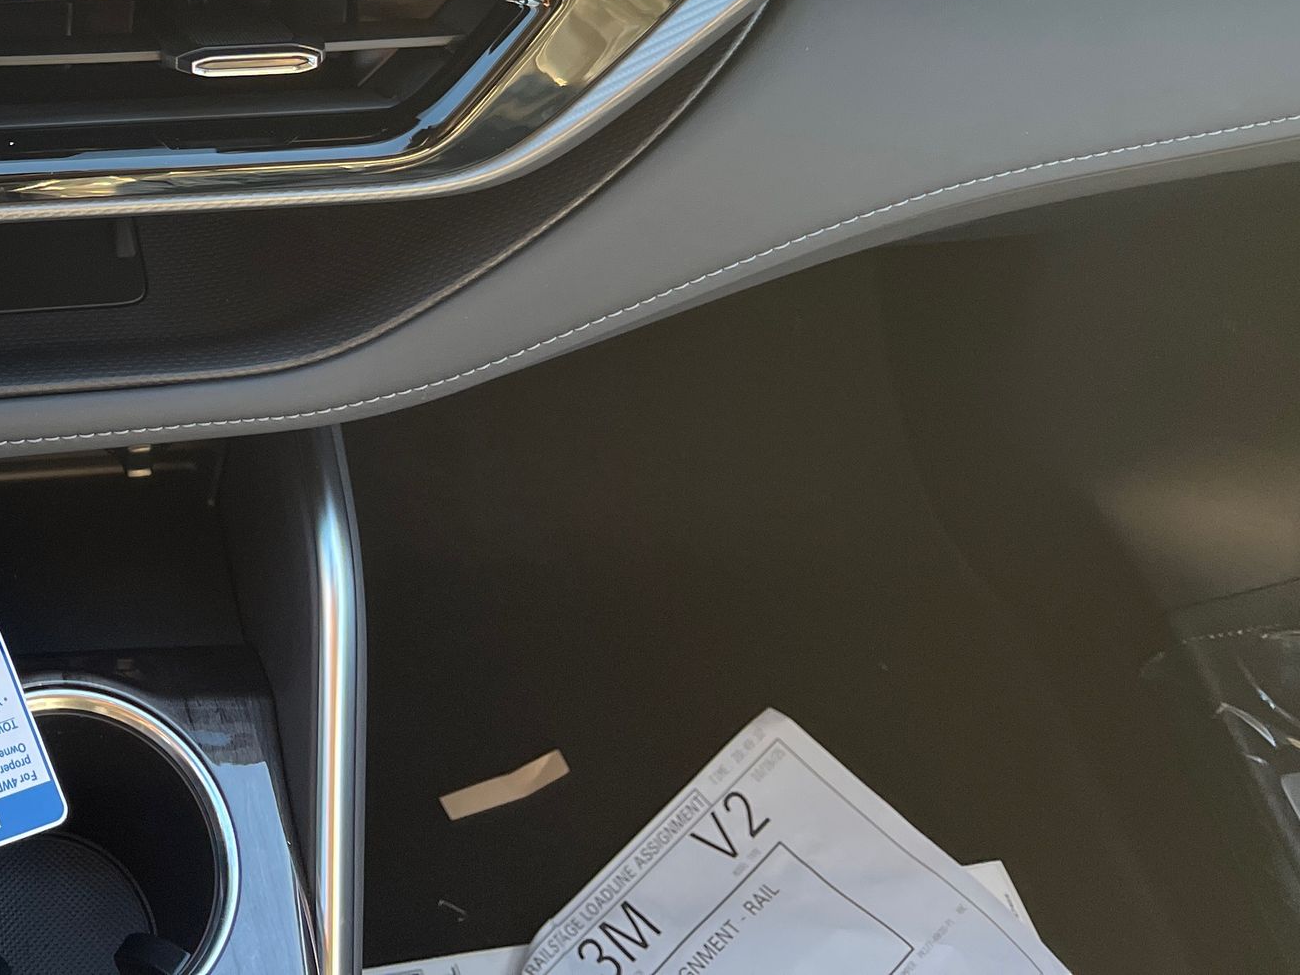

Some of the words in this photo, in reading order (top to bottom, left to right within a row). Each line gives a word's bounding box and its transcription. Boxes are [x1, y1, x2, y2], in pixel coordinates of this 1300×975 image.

[18, 769, 37, 785] For
[690, 791, 771, 858] V2
[522, 916, 583, 975] RAILSTAGE
[579, 864, 636, 923] LOADLINE
[632, 793, 706, 871] ASSIGNMENT
[742, 884, 780, 916] RAIL
